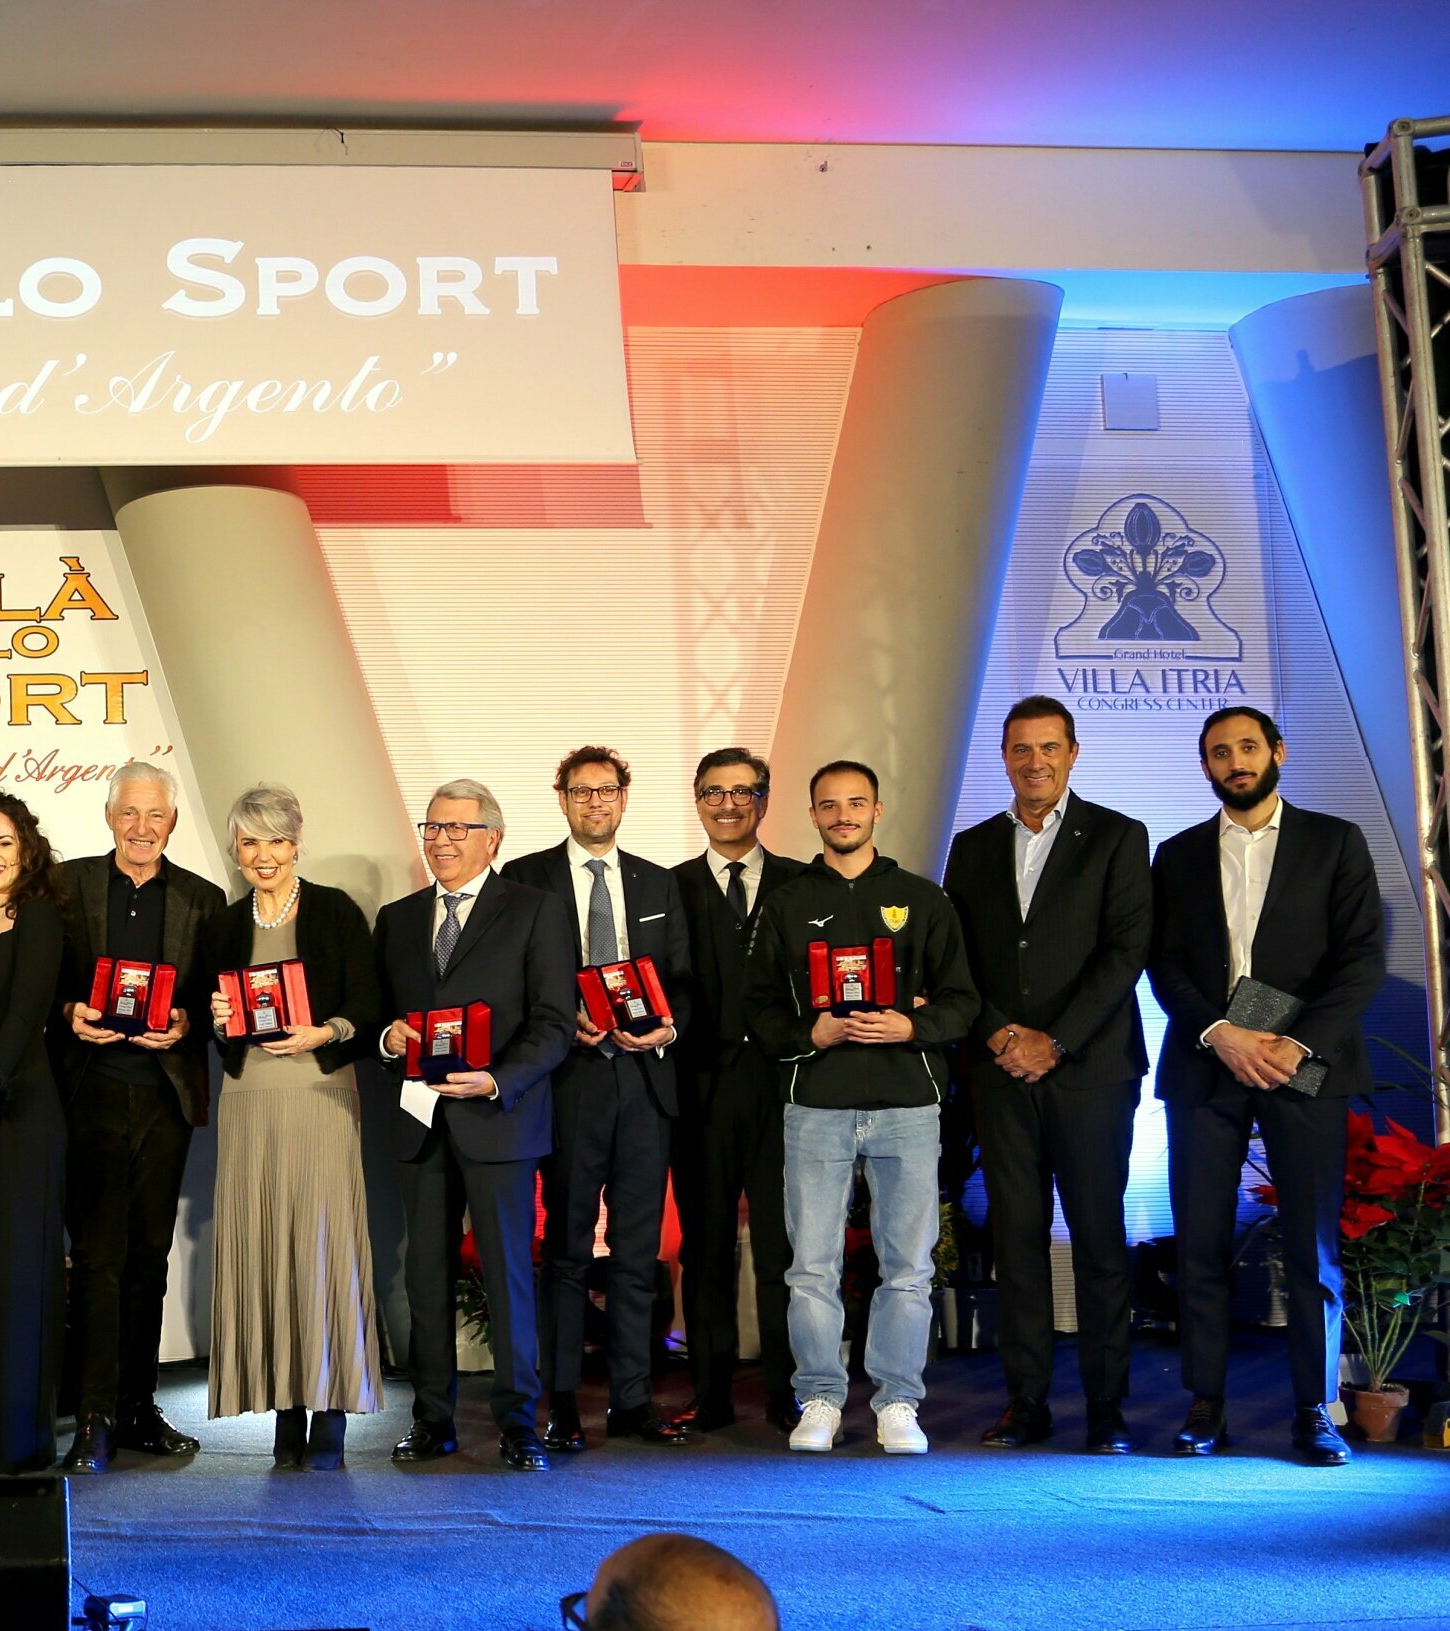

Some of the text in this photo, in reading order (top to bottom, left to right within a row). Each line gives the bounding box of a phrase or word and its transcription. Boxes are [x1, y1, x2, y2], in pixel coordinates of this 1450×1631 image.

[162, 237, 559, 318] SPORT
[1113, 648, 1186, 660] Grand Hotel
[1057, 667, 1247, 695] VILLA ITRIA
[1077, 697, 1229, 711] CONGRESS CENTER
